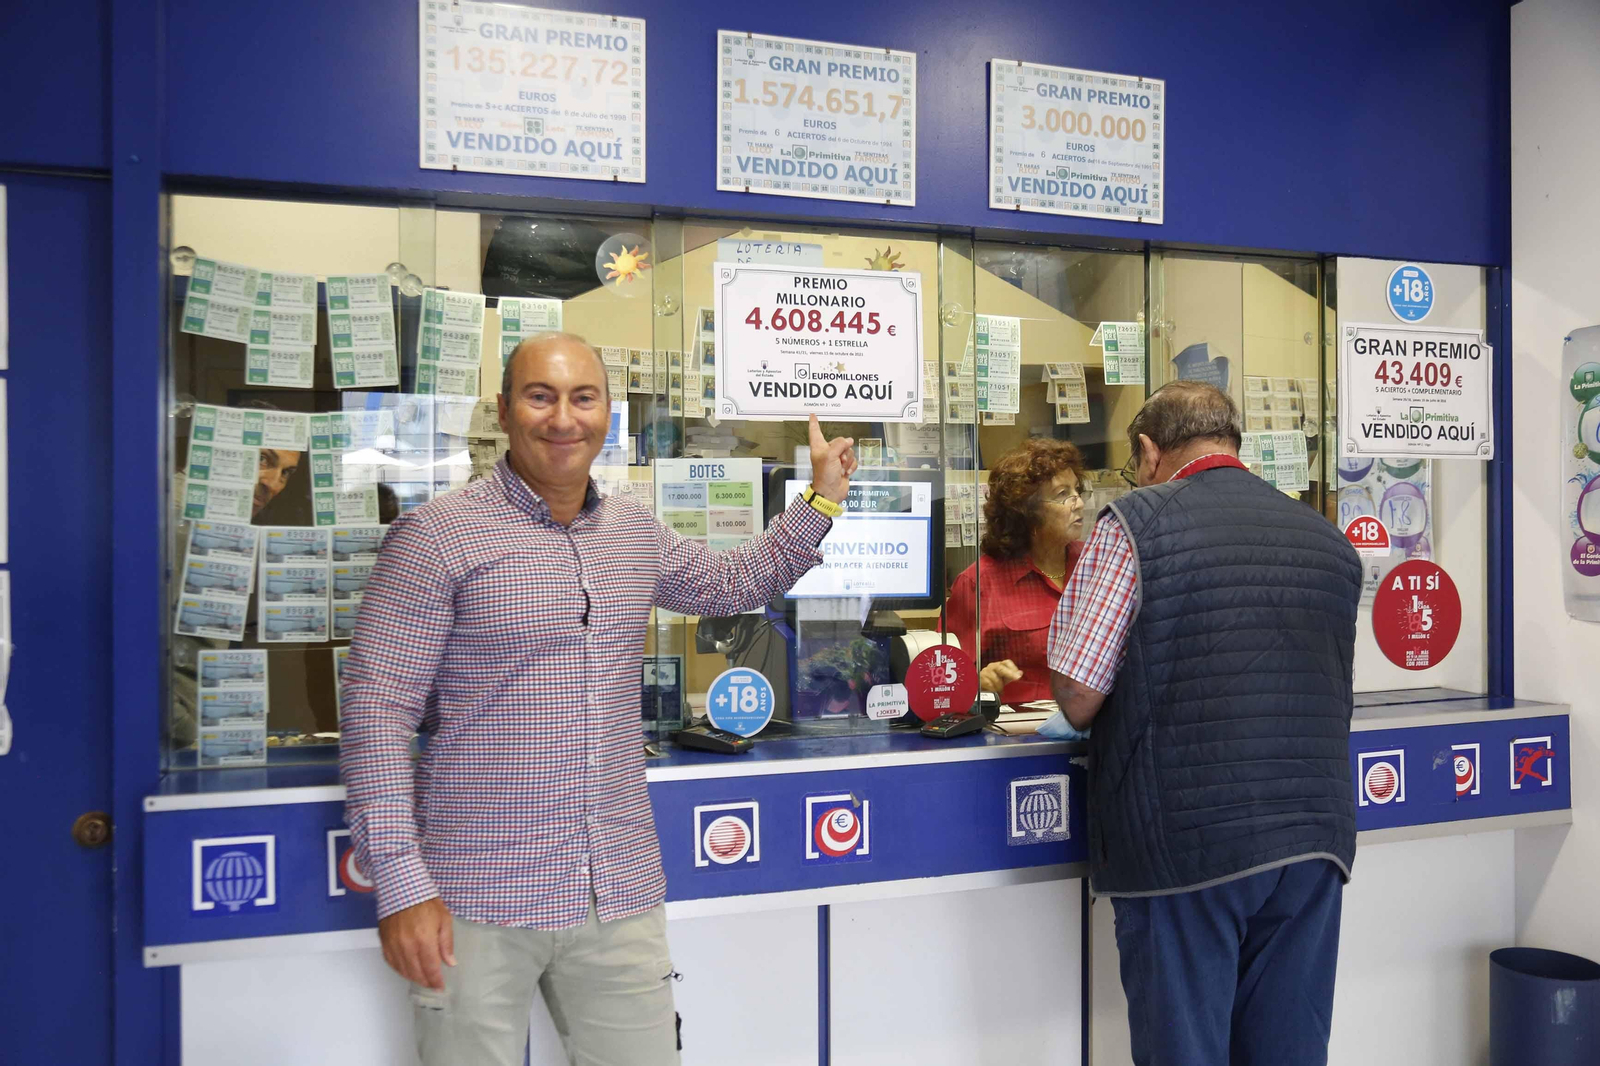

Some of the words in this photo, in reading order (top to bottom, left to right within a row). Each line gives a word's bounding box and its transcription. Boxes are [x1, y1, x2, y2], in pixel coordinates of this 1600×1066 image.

[480, 22, 538, 43] GRAN
[546, 30, 628, 51] PREMIO
[444, 45, 628, 86] 135.227,72
[769, 56, 821, 75] GRAN
[828, 62, 899, 83] PREMIO
[519, 91, 556, 103] EUROS
[734, 78, 903, 123] 1.574.651,7
[1037, 83, 1081, 101] GRAN
[1088, 89, 1150, 109] PREMIO
[451, 101, 473, 109] Premio
[505, 105, 548, 114] ACIERTOS
[804, 119, 836, 130] EUROS
[1021, 105, 1146, 142] 3.000.000
[446, 131, 557, 155] VENDIDO
[564, 138, 622, 162] AQUÍ
[787, 132, 826, 141] ACIERTOS
[850, 137, 871, 145] Octubre
[748, 146, 771, 154] RICO
[809, 151, 850, 161] Primitiva
[1066, 142, 1095, 153] EUROS
[854, 156, 890, 164] FAMOSO
[1052, 153, 1086, 163] ACIERTOS
[736, 156, 838, 180] VENDIDO
[844, 164, 898, 187] AQUÍ
[1071, 173, 1107, 182] Primitiva
[1110, 176, 1141, 184] FAMOSO
[1008, 176, 1096, 199] VENDIDO
[1102, 184, 1148, 206] AQUÍ
[794, 277, 847, 291] PREMIO
[1393, 279, 1423, 302] +18
[776, 293, 865, 308] MILLONARIO
[746, 307, 881, 334] 4.608.445
[887, 325, 896, 336] €
[782, 337, 820, 347] NÚMEROS
[834, 340, 868, 348] ESTRELLA
[1354, 338, 1406, 356] GRAN
[1414, 341, 1481, 360] PREMIO
[812, 373, 878, 381] EUROMILLONES
[1375, 360, 1451, 387] 43.409
[1455, 376, 1462, 388] €
[749, 382, 837, 398] VENDIDO
[845, 381, 893, 401] AQUÍ
[1412, 388, 1461, 396] COMPLEMENTARIO
[1400, 412, 1408, 420] La
[1425, 413, 1458, 422] Primitiva
[1361, 423, 1432, 440] VENDIDO
[1437, 422, 1474, 441] AQUÍ
[690, 464, 725, 478] BOTES
[1352, 522, 1379, 541] +18
[822, 542, 908, 555] ENVENIDO
[1392, 576, 1404, 590] A
[1408, 576, 1420, 590] TI
[1426, 571, 1439, 590] SÍ
[1412, 595, 1418, 612] 1
[1422, 609, 1433, 631] 5
[935, 650, 941, 666] 1
[946, 663, 957, 683] 5
[715, 686, 758, 713] +18
